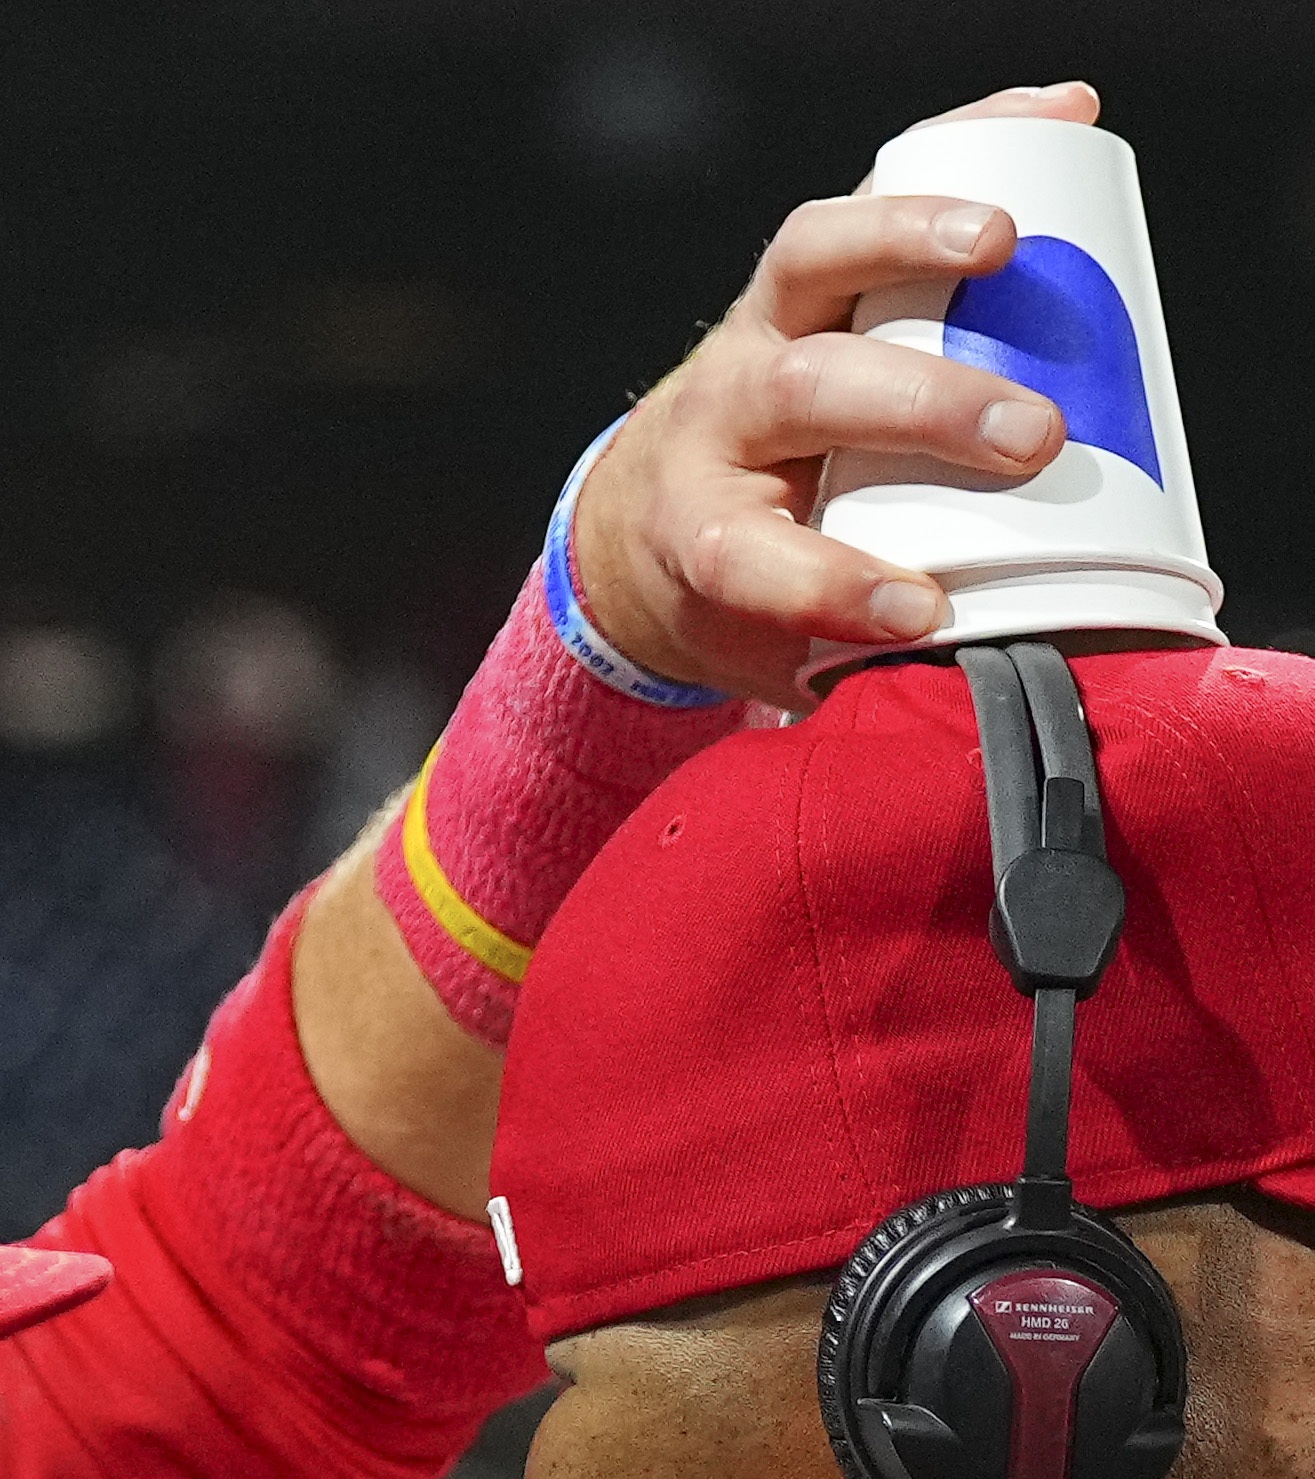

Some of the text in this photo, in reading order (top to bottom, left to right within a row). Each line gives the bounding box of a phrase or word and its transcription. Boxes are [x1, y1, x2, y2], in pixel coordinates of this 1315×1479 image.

[1015, 1303, 1095, 1315] SENNHEISER
[1021, 1316, 1070, 1329] HMD 26
[1010, 1332, 1032, 1340] MADE
[1043, 1333, 1080, 1341] GERMANY
